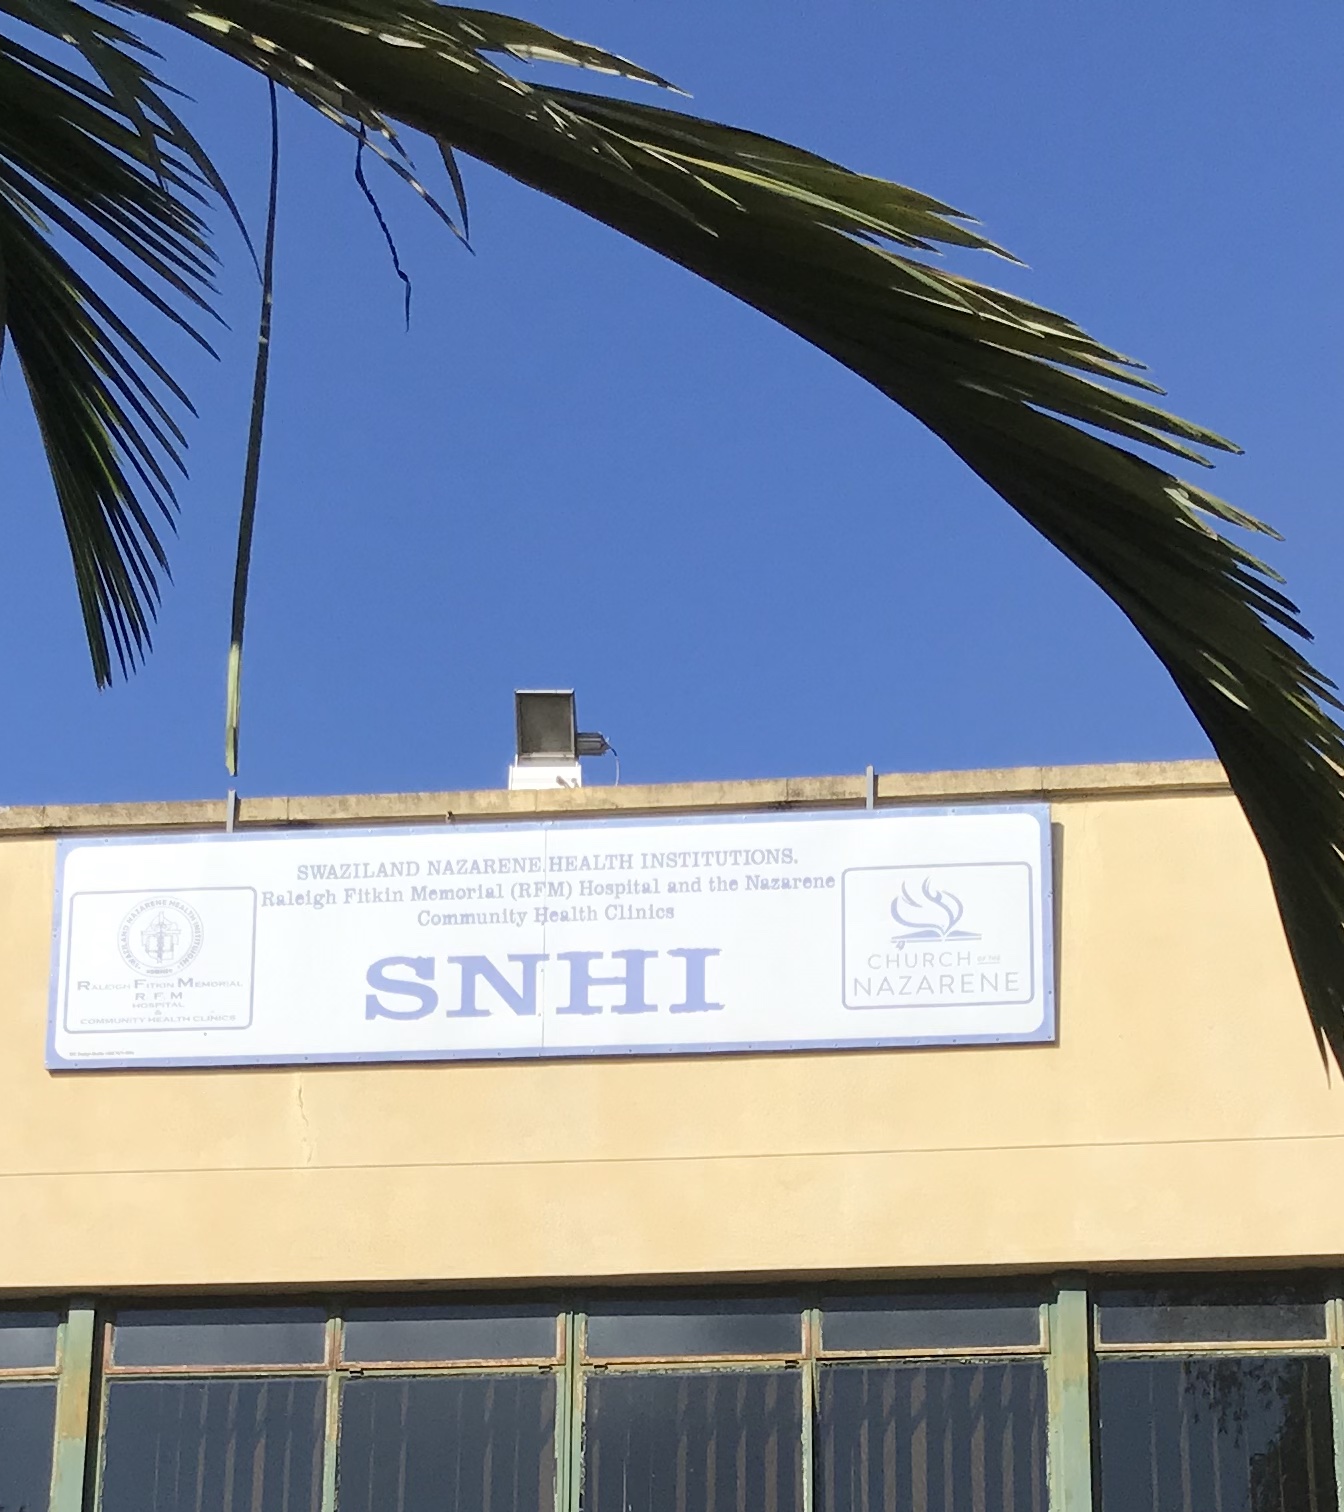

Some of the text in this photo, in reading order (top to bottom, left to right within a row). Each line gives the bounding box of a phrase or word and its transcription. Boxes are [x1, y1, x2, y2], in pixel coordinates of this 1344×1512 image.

[297, 848, 798, 880] SWAZILAND NAZARENE HEALTH INSTITUTIONS.
[261, 874, 836, 910] Raleigh Fitkin Memorial (RFM) Hospital and the Nazarene
[417, 904, 675, 927] Community Health Clinics
[867, 951, 971, 970] CHURCH
[988, 954, 1001, 962] THE
[135, 991, 183, 1001] R F M
[365, 947, 726, 1022] SNHI
[854, 971, 1019, 997] NAZARENE
[80, 1014, 236, 1025] COMMUNITY HEALTH CLINICS
